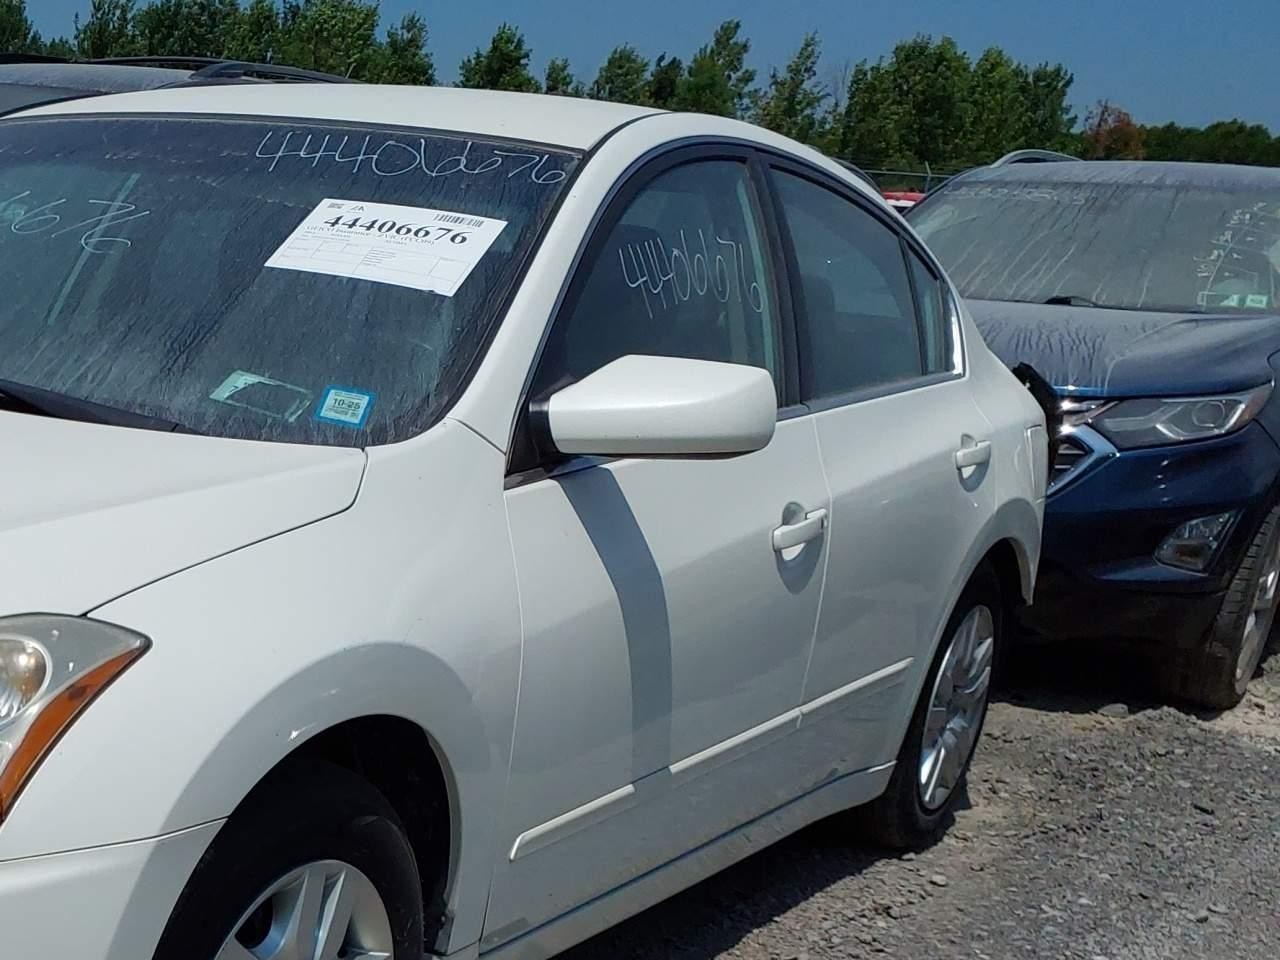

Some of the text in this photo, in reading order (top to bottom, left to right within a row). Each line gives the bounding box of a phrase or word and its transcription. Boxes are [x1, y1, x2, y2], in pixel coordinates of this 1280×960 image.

[255, 130, 567, 184] 44406676
[324, 214, 473, 244] 44406676
[333, 397, 361, 410] 10-25
